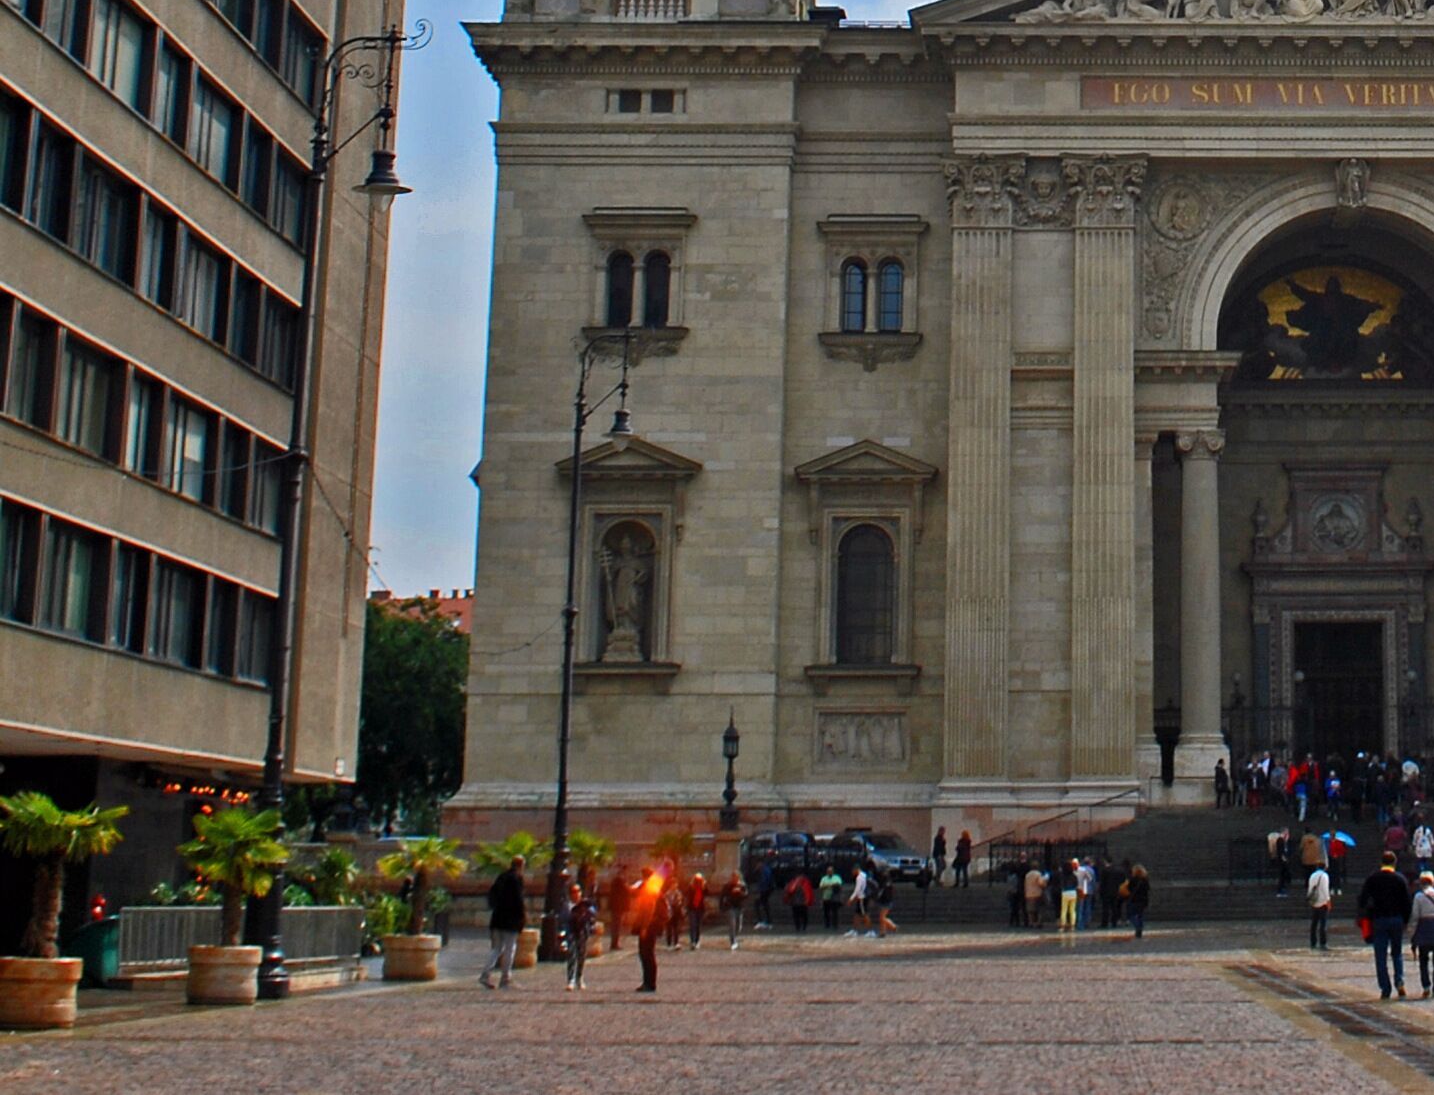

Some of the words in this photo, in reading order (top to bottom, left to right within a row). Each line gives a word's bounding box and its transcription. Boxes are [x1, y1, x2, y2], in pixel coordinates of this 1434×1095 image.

[1112, 82, 1171, 104] EGO
[1190, 82, 1252, 104] SUM
[1276, 82, 1325, 105] VIA
